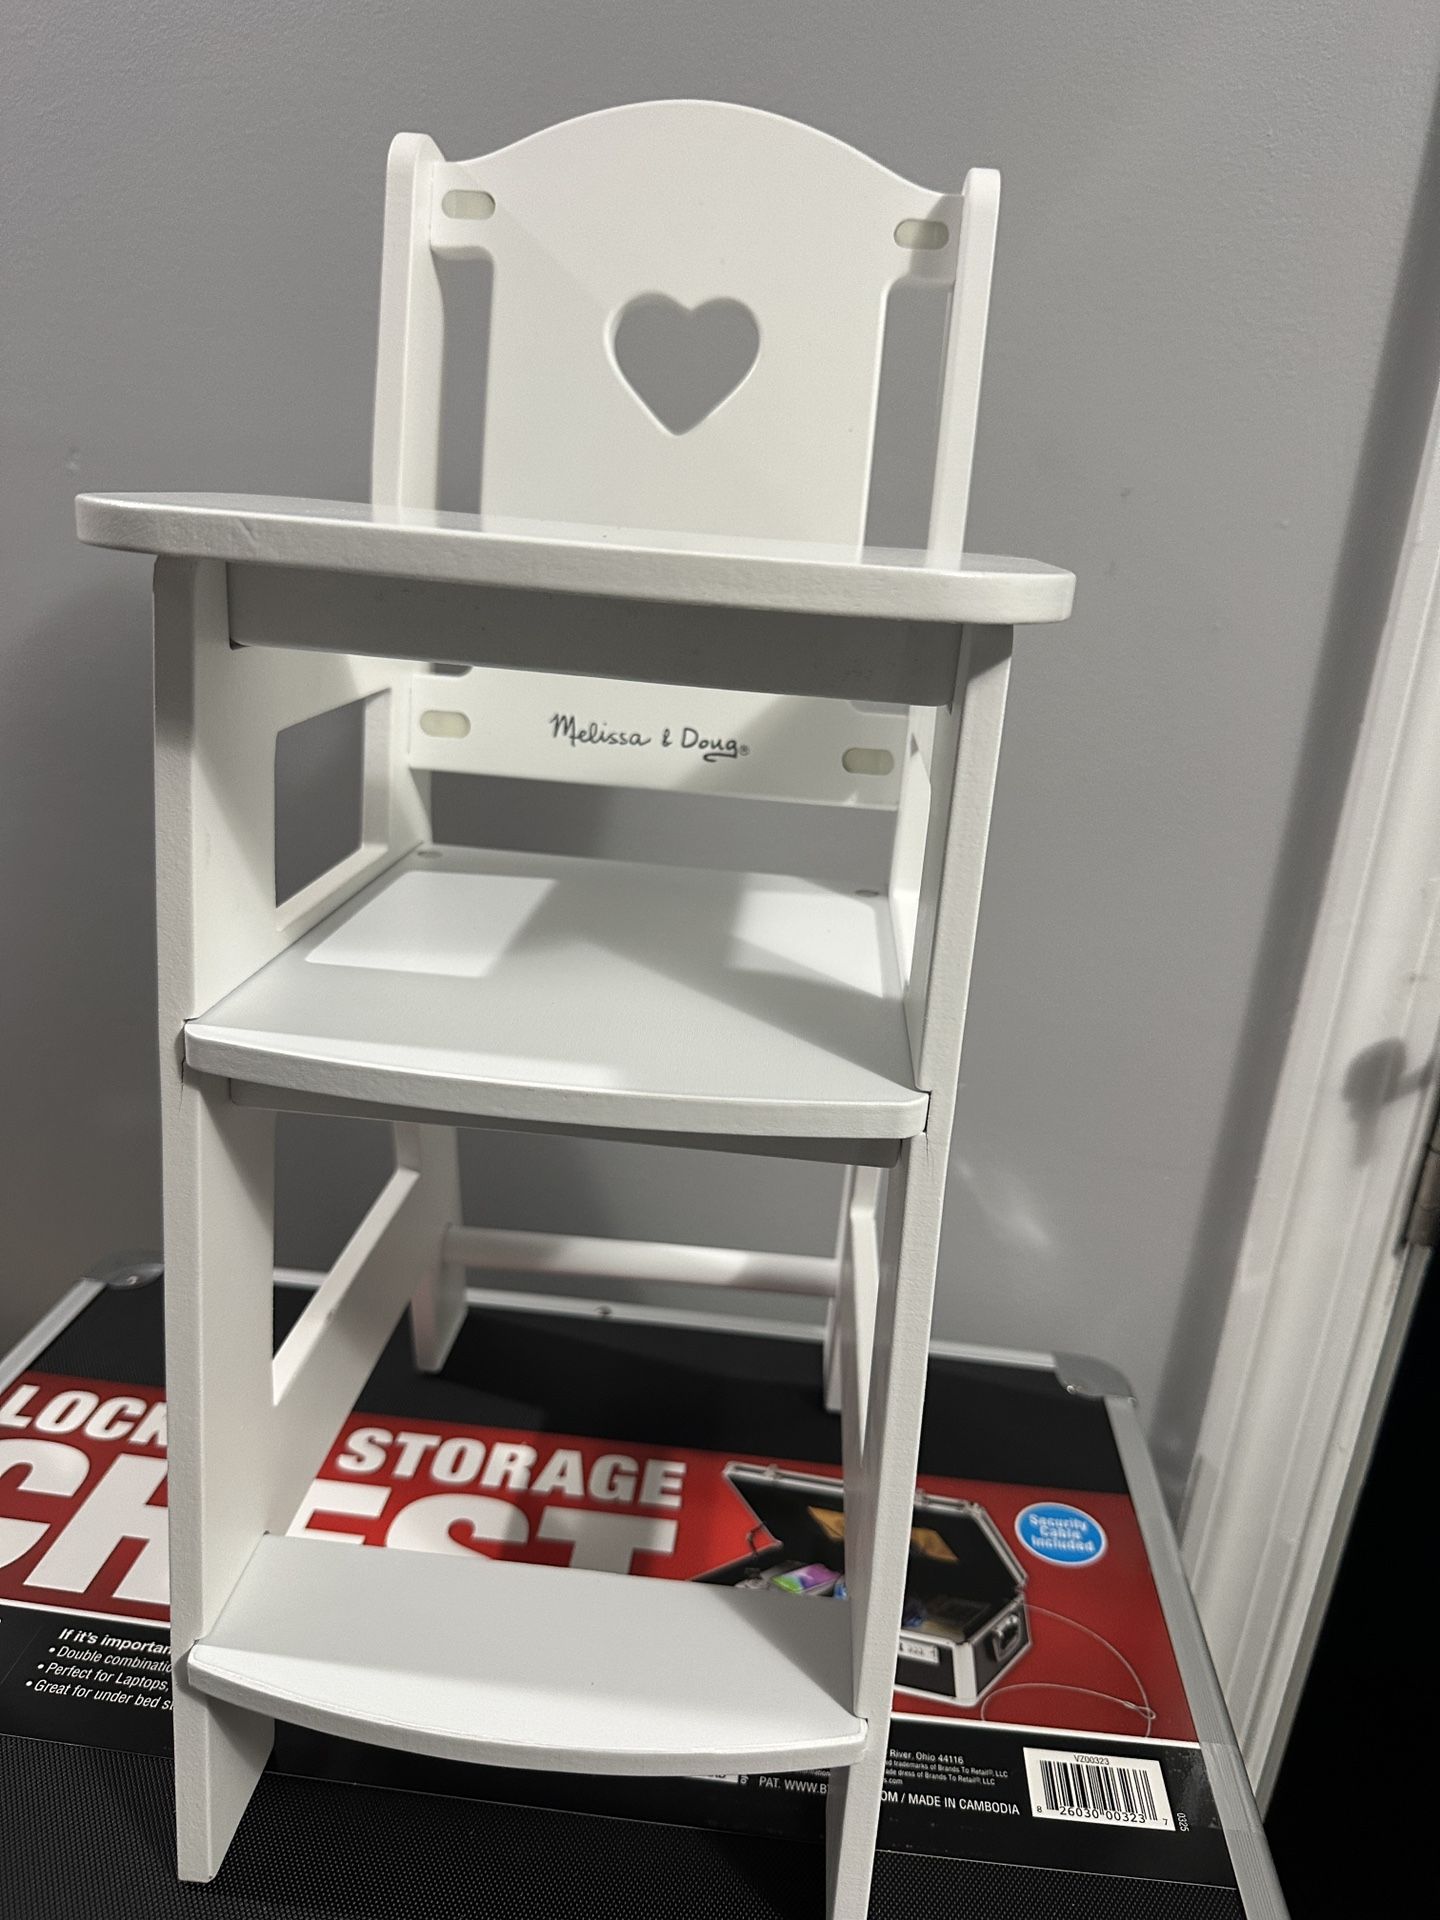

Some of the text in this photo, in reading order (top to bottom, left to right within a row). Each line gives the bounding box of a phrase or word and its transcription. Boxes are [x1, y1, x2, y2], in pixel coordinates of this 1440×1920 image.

[550, 713, 651, 747] Melissa
[662, 728, 673, 747] &
[336, 1427, 686, 1509] STORAGE
[1029, 1514, 1088, 1532] Security
[1040, 1525, 1082, 1540] Cable
[1031, 1535, 1096, 1553] Included
[58, 1628, 73, 1640] If
[74, 1630, 99, 1644] it's
[56, 1645, 103, 1663] Double
[45, 1662, 169, 1692] Perfect for Laptops,
[34, 1679, 72, 1695] Great
[71, 1685, 93, 1698] for
[94, 1689, 134, 1704] under
[134, 1694, 161, 1708] bed
[916, 1751, 936, 1762] Ohio
[938, 1754, 964, 1765] 44116
[1073, 1754, 1110, 1765] VZ00323
[893, 1760, 928, 1770] trademarks
[938, 1764, 960, 1773] Brands
[961, 1766, 969, 1774] To
[995, 1769, 1008, 1778] LLC
[916, 1770, 924, 1778] of
[925, 1771, 947, 1781] Brands
[948, 1773, 956, 1781] To
[982, 1778, 995, 1786] LLC
[759, 1775, 781, 1788] PAT.
[901, 1792, 906, 1804] /
[908, 1793, 941, 1807] MADE
[944, 1796, 956, 1809] IN
[959, 1798, 1020, 1815] CAMBODIA
[1036, 1805, 1169, 1826] 8 26030 00323 7
